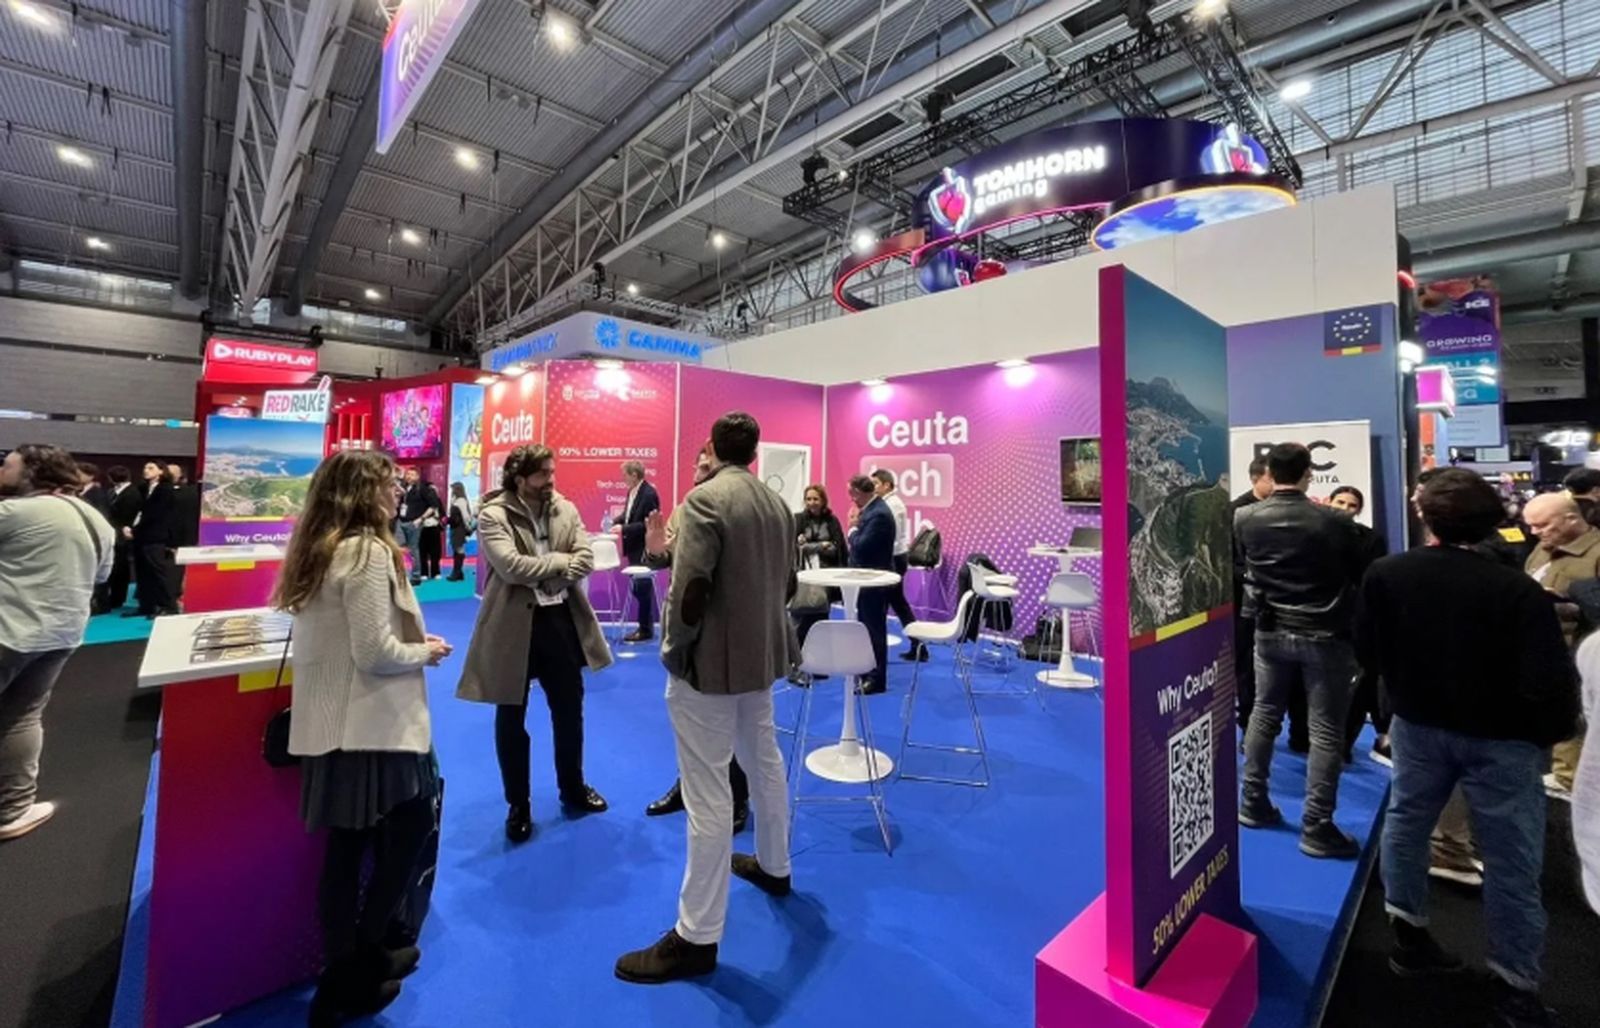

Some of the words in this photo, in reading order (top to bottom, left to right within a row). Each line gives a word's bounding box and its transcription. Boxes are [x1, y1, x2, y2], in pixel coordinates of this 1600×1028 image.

[973, 146, 1106, 195] TOMHORN
[974, 179, 1048, 214] gaming
[234, 347, 314, 366] RUBYPLAY
[1426, 334, 1492, 348] GROWING
[491, 409, 533, 445] Ceuta
[867, 411, 969, 449] Ceuta
[559, 447, 581, 457] 50%
[584, 447, 622, 457] LOWER
[624, 447, 658, 458] TAXES
[868, 461, 942, 497] ch
[1311, 476, 1340, 484] UTA
[224, 533, 250, 545] Why
[1157, 685, 1182, 715] Why
[1183, 660, 1218, 700] Ceuta?
[1152, 910, 1174, 954] 50%
[1175, 872, 1206, 926] LOWER
[1206, 843, 1229, 886] TAXES
